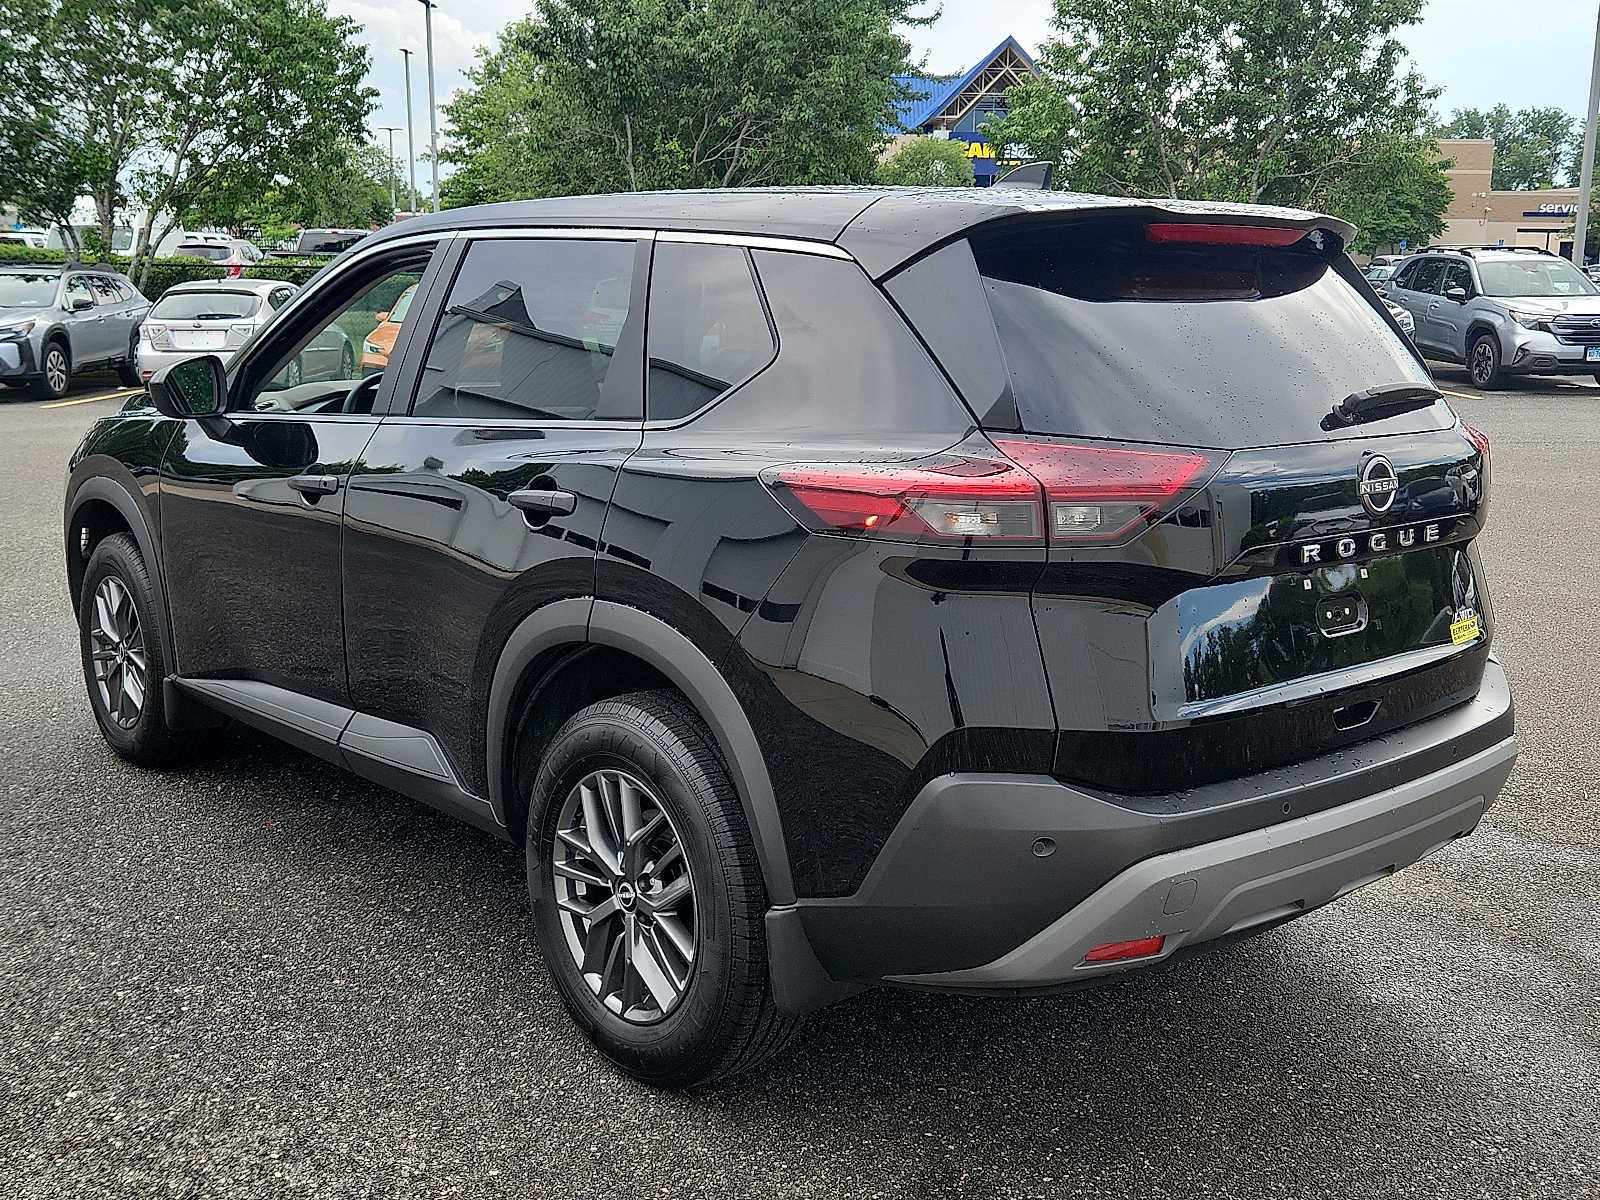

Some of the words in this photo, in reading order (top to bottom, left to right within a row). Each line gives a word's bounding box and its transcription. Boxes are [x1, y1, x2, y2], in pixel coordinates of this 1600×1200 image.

[1540, 203, 1579, 213] servic
[1361, 480, 1398, 494] NISSAN
[1302, 523, 1440, 564] ROGUE
